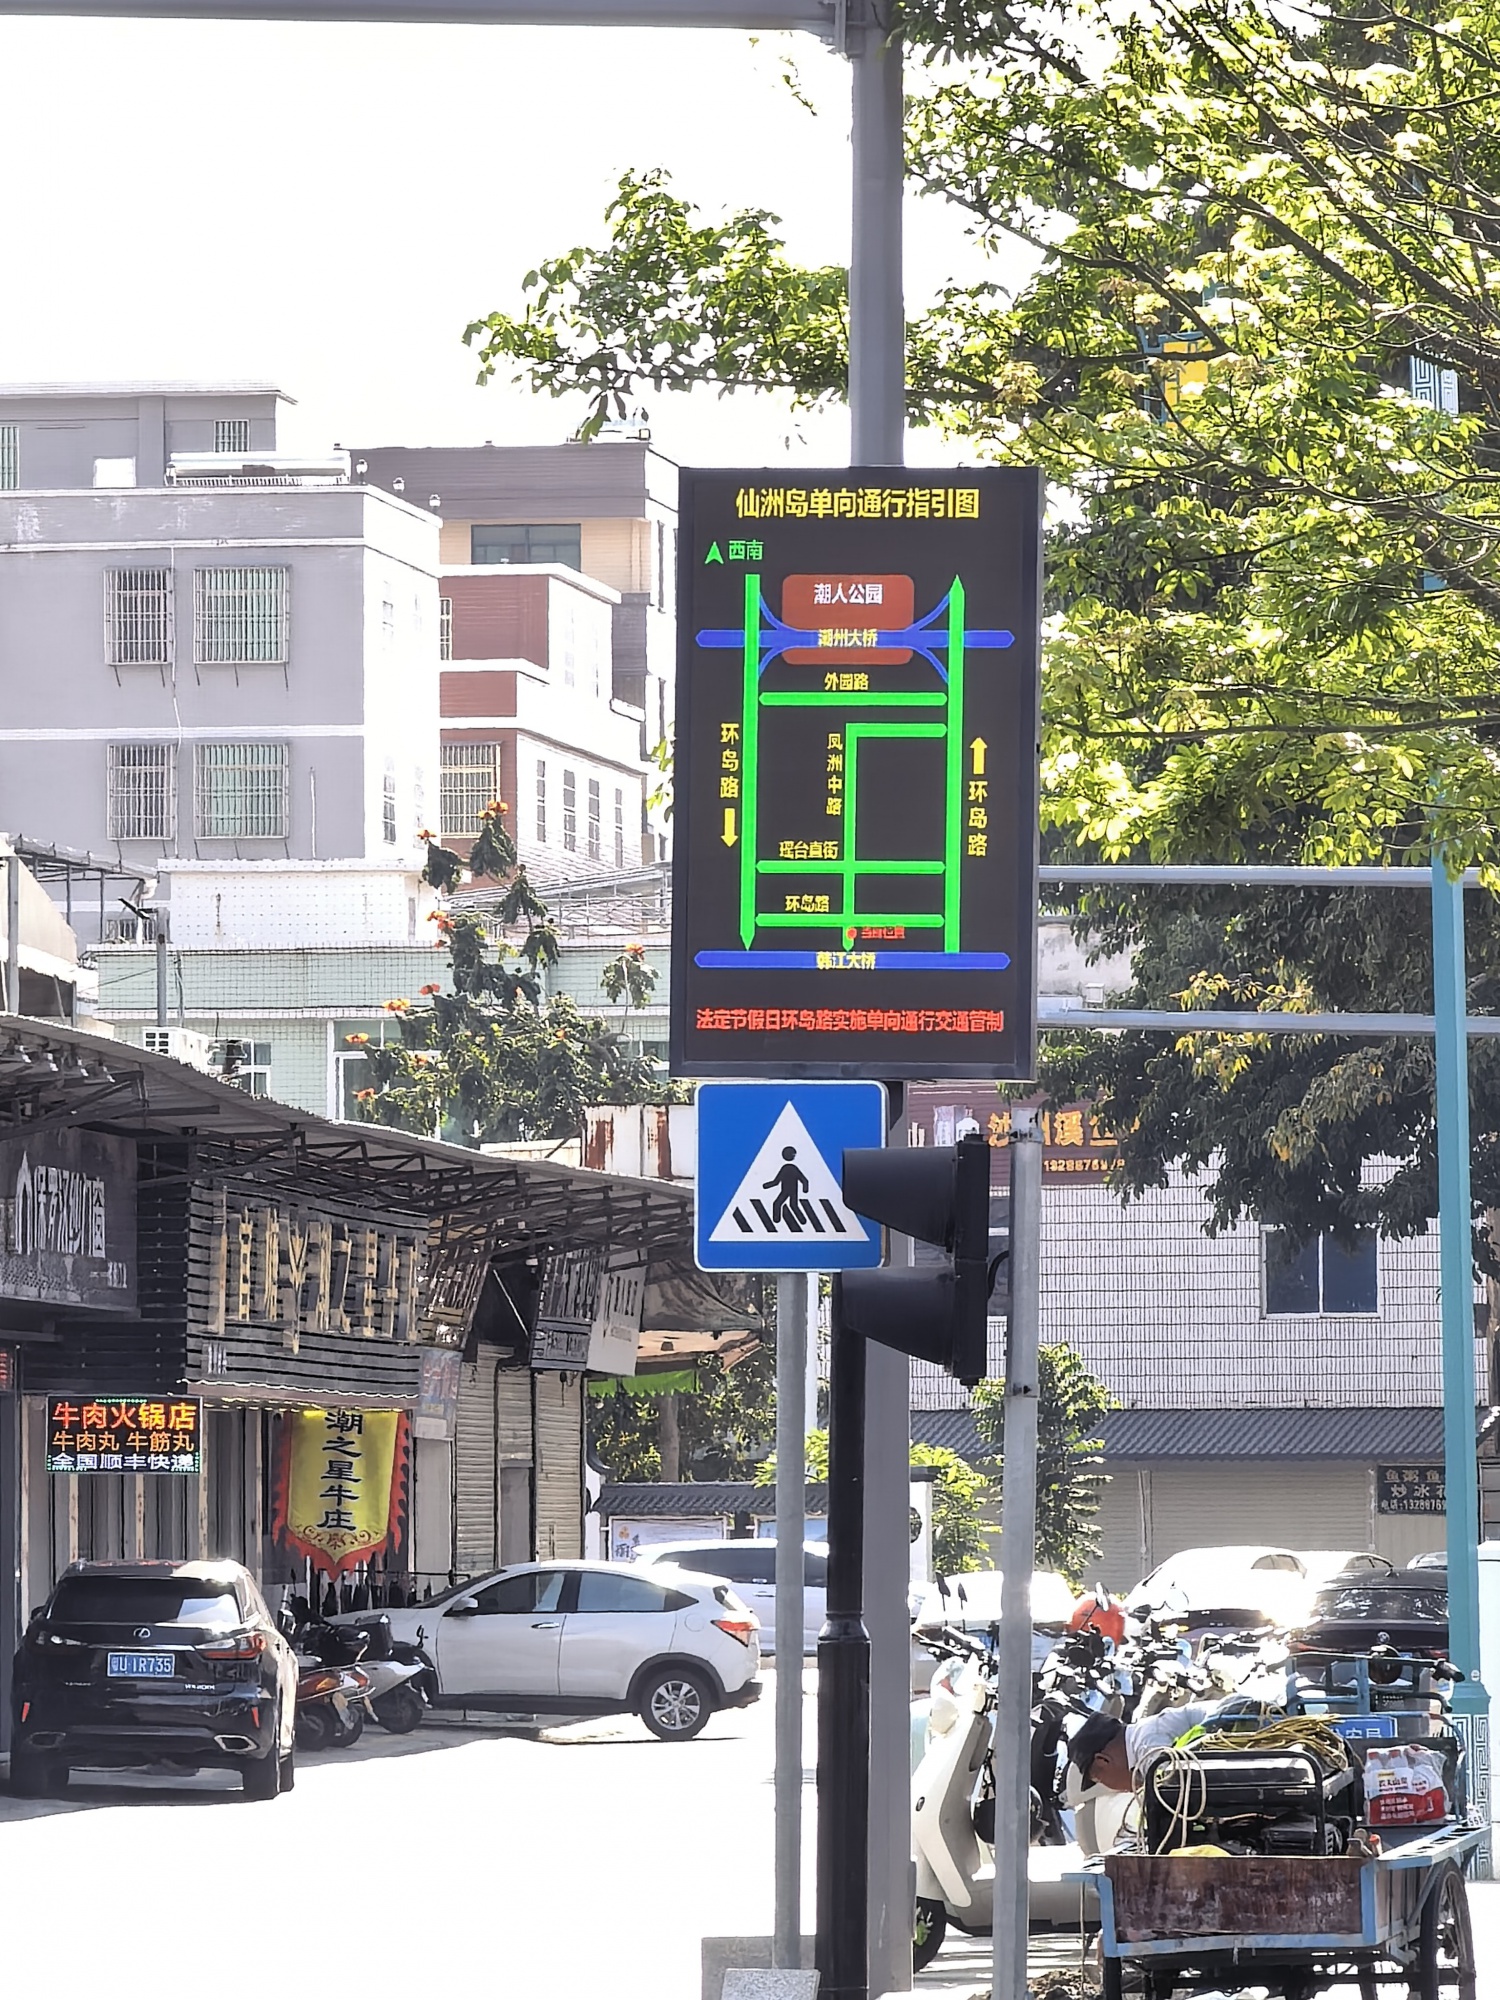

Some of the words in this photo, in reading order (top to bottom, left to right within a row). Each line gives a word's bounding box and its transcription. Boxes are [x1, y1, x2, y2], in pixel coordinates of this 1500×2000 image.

[736, 488, 980, 519] 仙洲岛单向通行指引图
[728, 540, 764, 561] 西南
[813, 582, 883, 605] 潮人公园
[817, 628, 878, 648] 潮州大桥
[824, 672, 869, 692] 外园路
[720, 722, 740, 799] 环岛路
[826, 733, 844, 816] 凤洲中路
[967, 780, 988, 857] 环岛路
[785, 894, 830, 913] 环岛路
[816, 950, 876, 970] 韩江大桥
[696, 1008, 1005, 1033] 法定节假日环岛路实施单向通行交通管制
[52, 1401, 198, 1431] 牛肉火锅店
[52, 1430, 120, 1452] 牛肉丸
[126, 1431, 195, 1453] 牛筋丸
[51, 1452, 195, 1472] 全国顺丰快递
[316, 1408, 364, 1532] 潮之星牛庄
